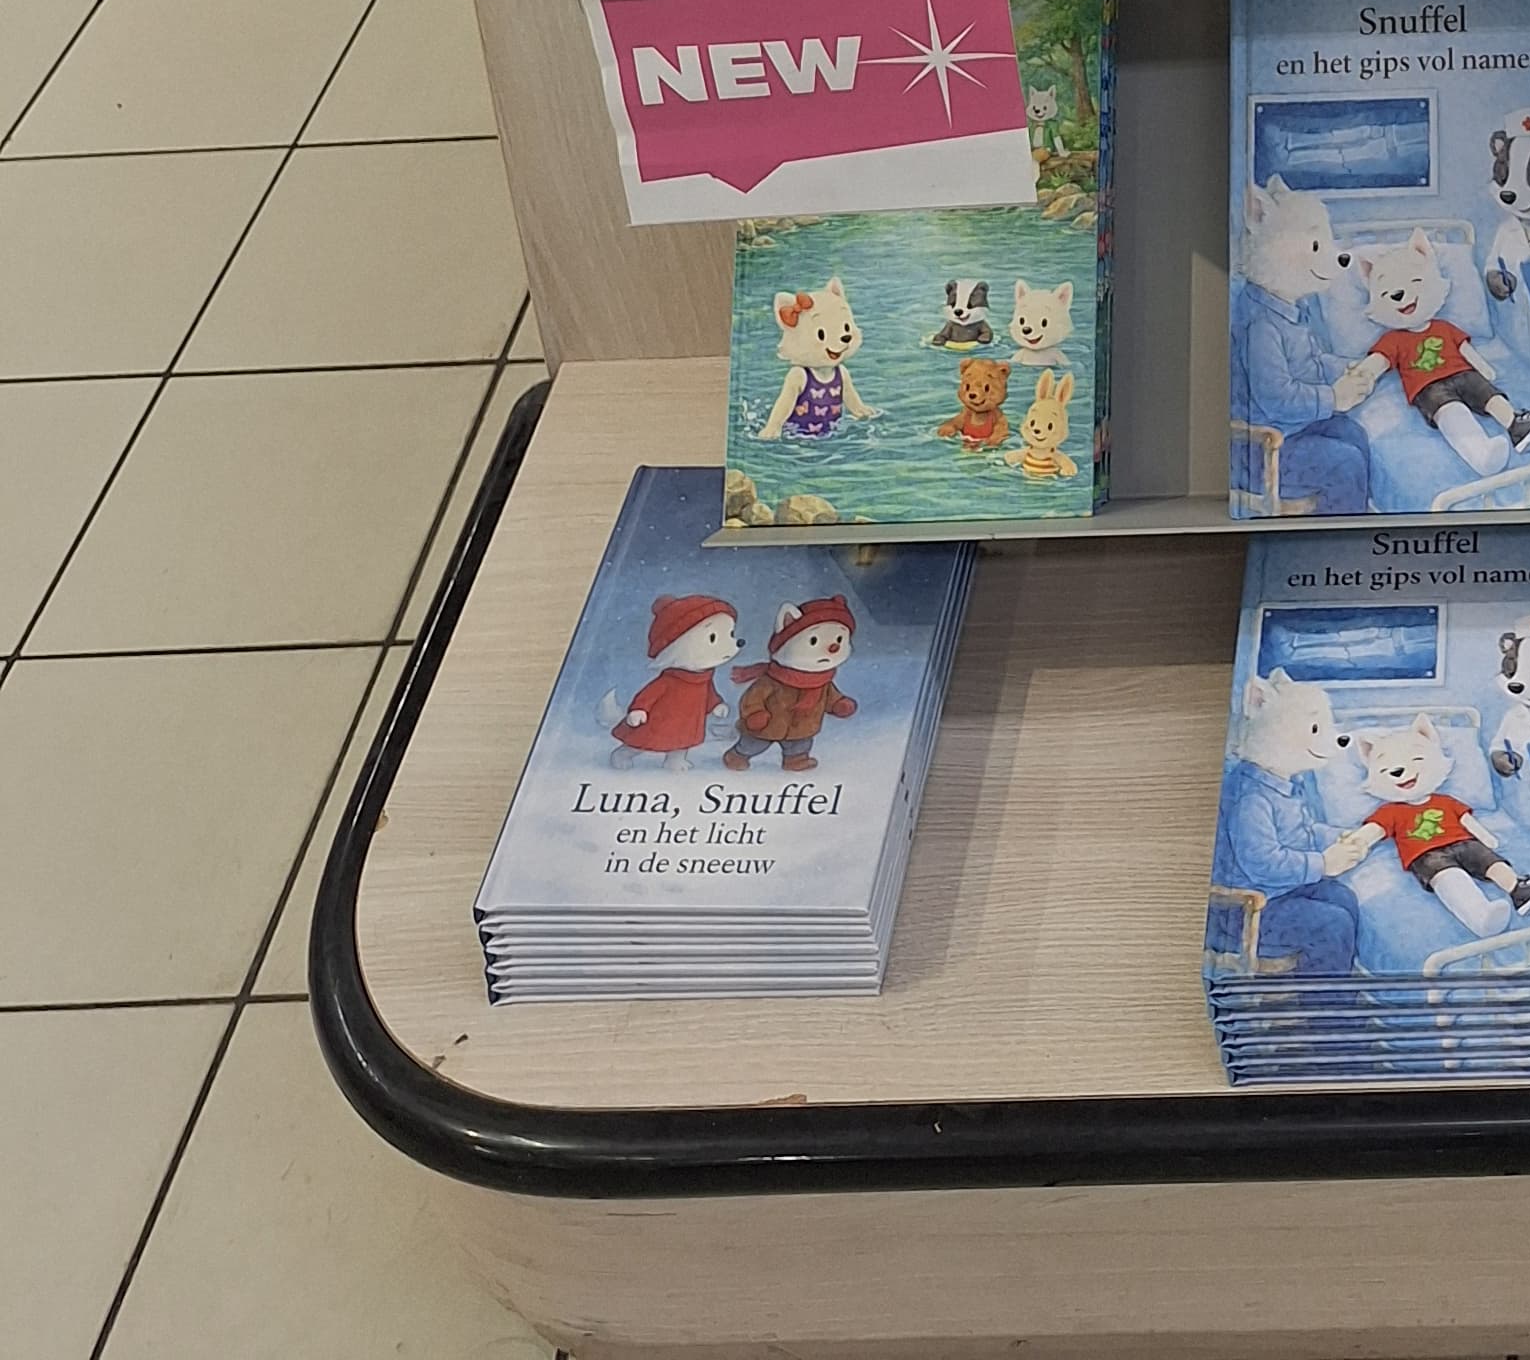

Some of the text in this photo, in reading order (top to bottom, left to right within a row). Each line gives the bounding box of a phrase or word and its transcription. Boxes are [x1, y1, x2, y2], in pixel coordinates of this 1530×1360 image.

[1359, 5, 1468, 36] Snuffel
[632, 35, 862, 106] NEW
[1276, 59, 1305, 77] en
[1313, 51, 1351, 75] het
[1359, 53, 1410, 81] gips
[1417, 50, 1455, 72] vol
[1372, 532, 1480, 558] Snuffel
[1287, 572, 1317, 589] en
[1324, 567, 1363, 588] het
[1370, 568, 1422, 592] gips
[1428, 565, 1466, 586] vol
[571, 782, 843, 819] Luna, Snuffel
[616, 822, 767, 845] en het licht
[604, 852, 776, 874] in de sneeuw
